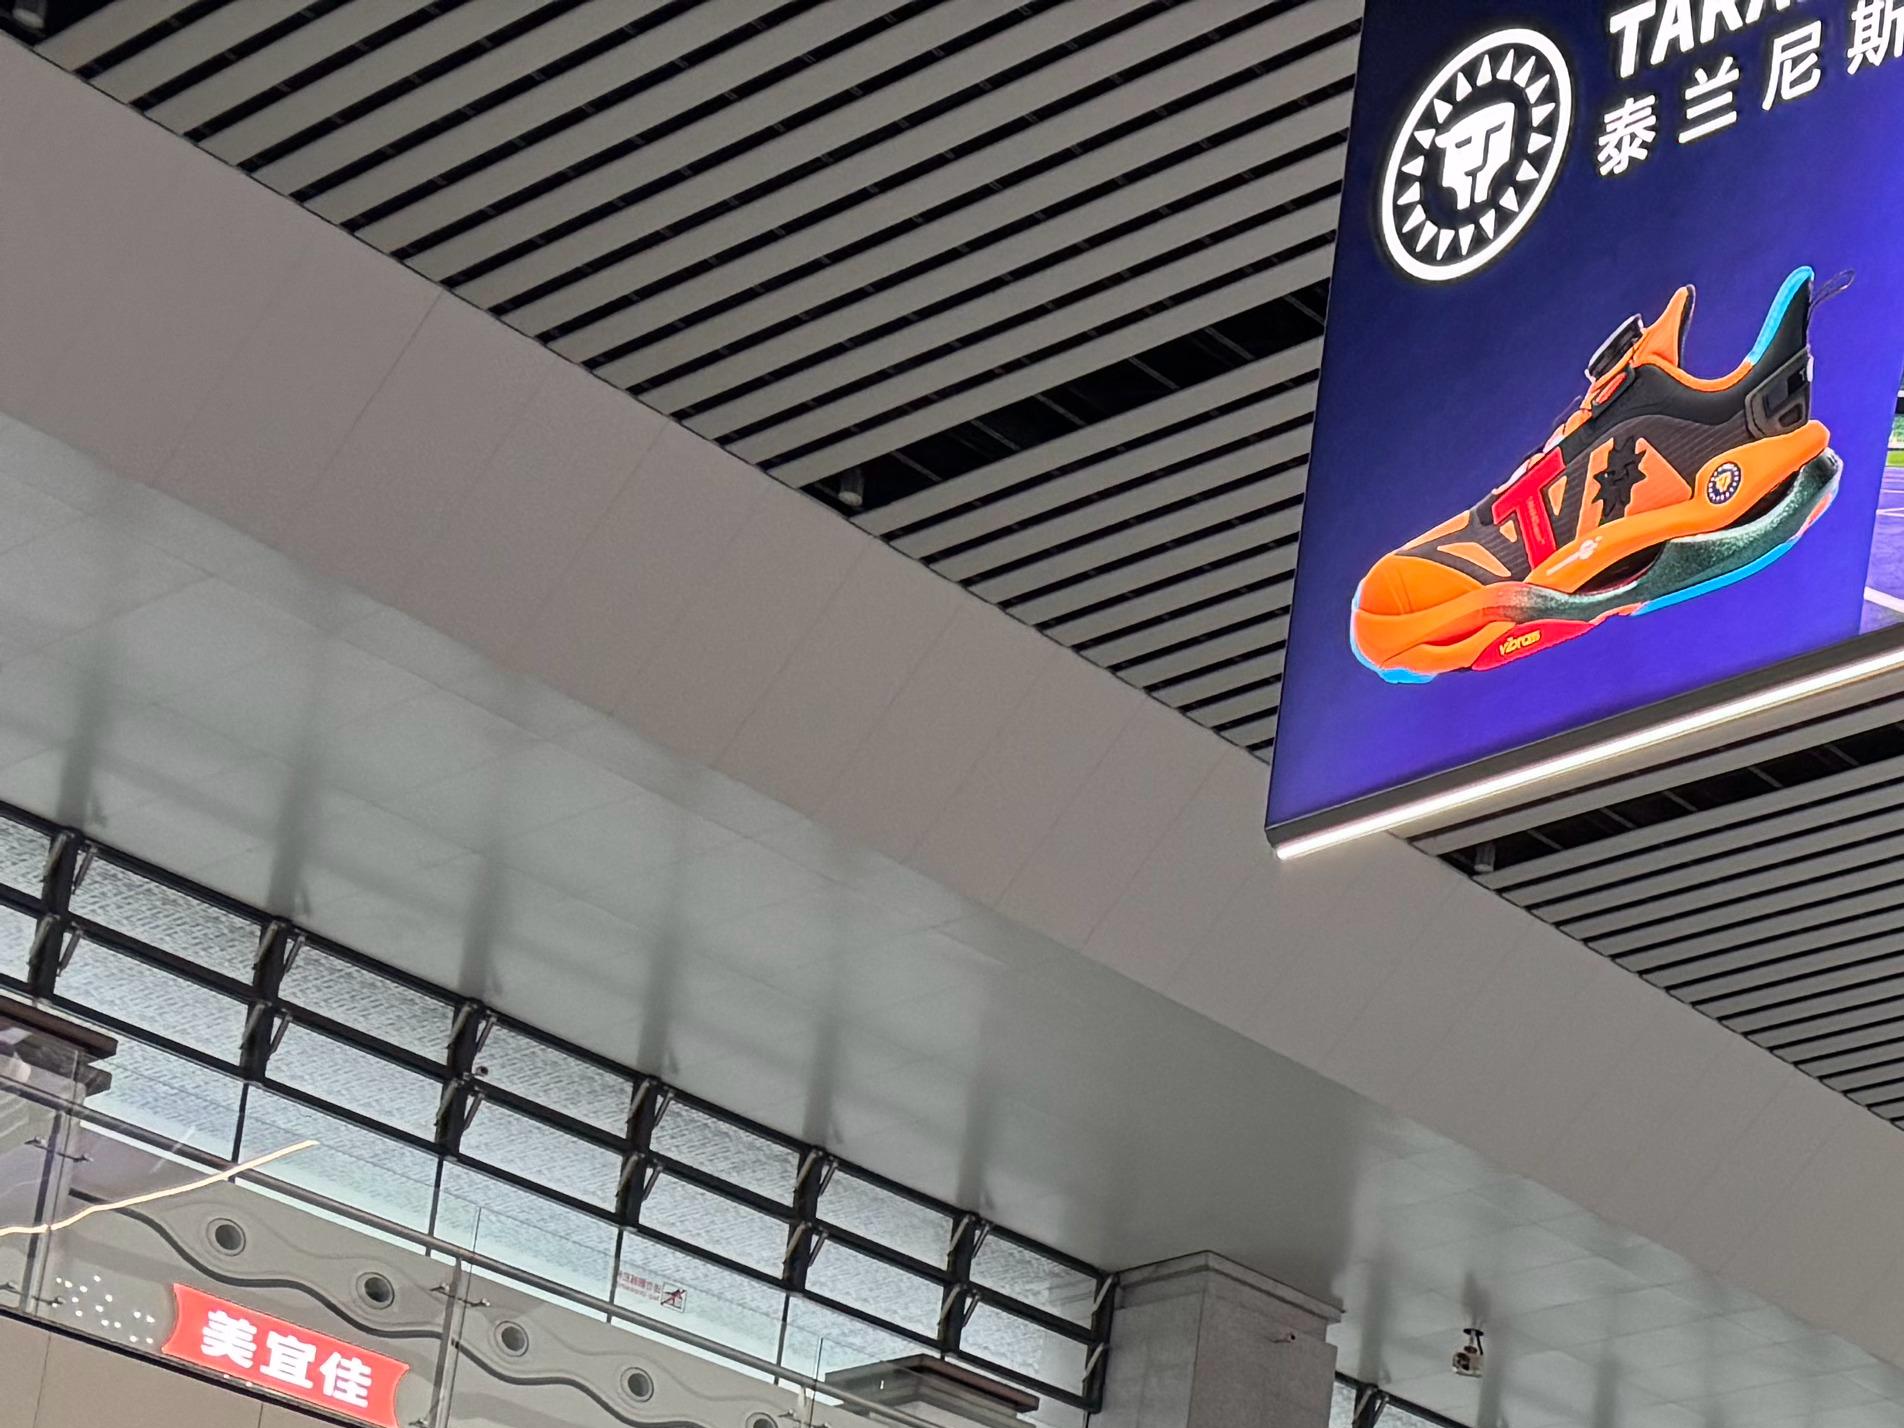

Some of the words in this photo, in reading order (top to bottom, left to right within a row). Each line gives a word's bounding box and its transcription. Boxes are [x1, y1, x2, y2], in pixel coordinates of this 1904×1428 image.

[1609, 0, 1792, 79] TAR
[200, 1309, 374, 1409] 美宜佳
